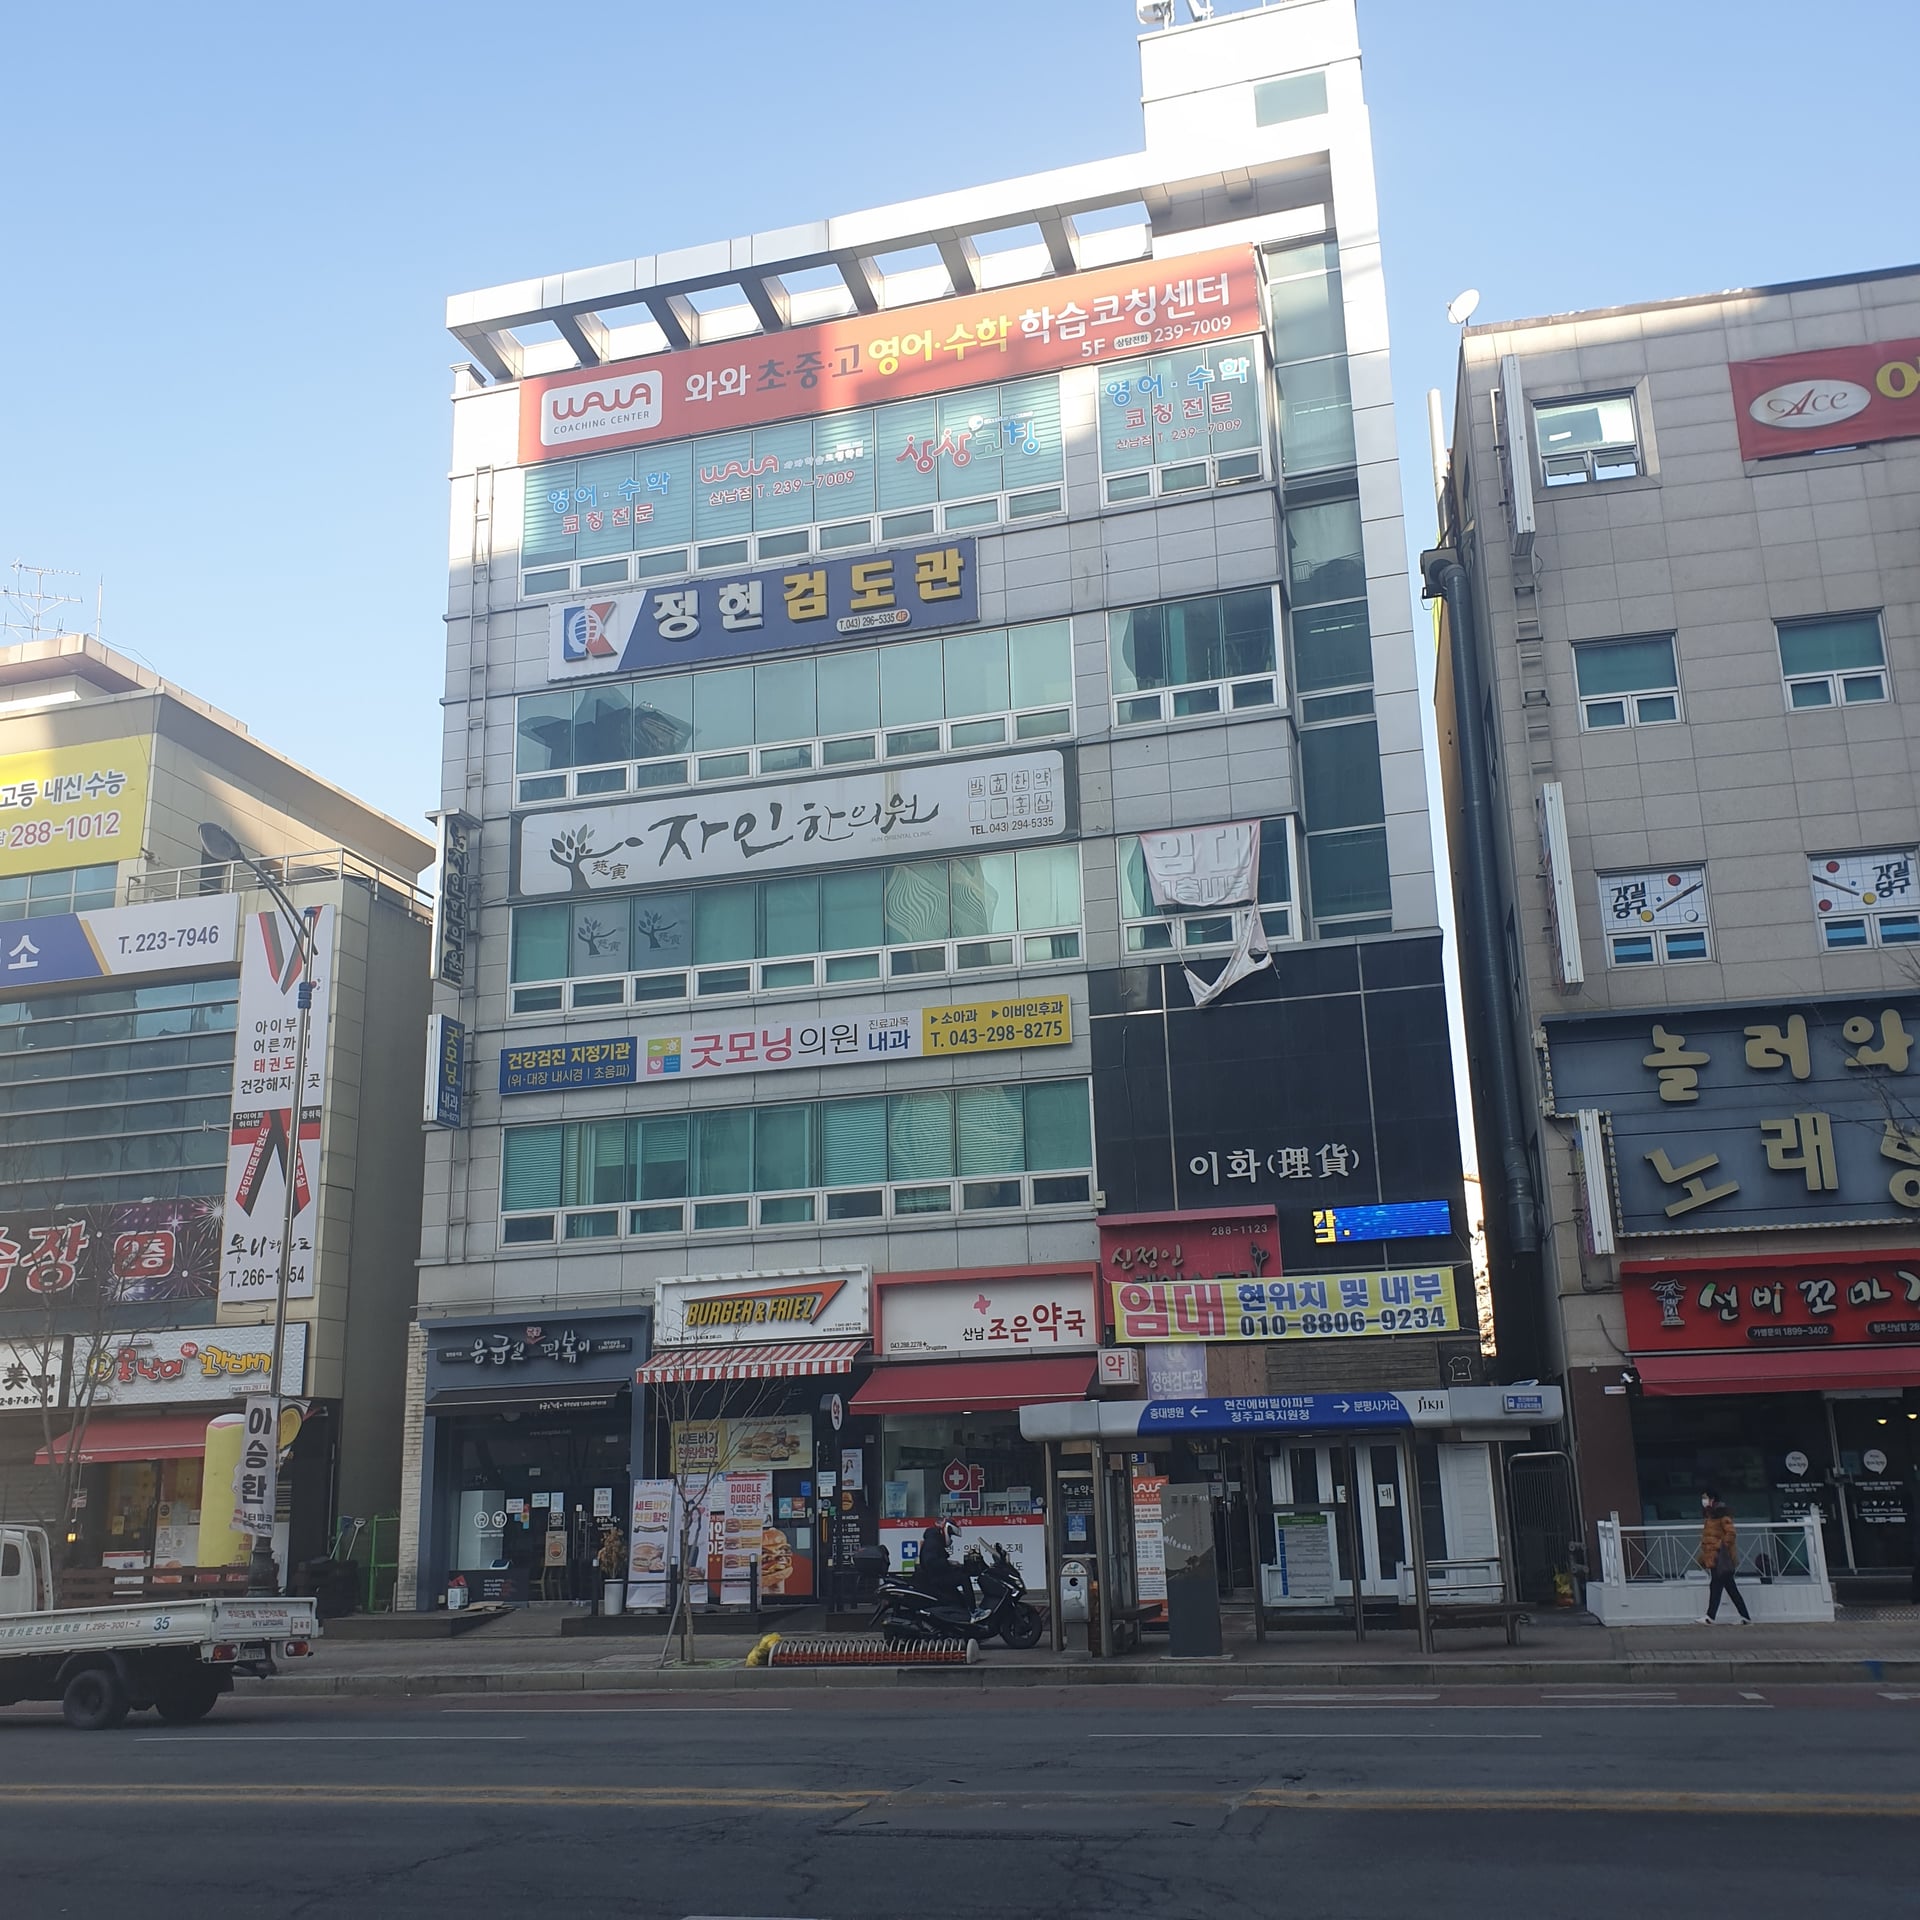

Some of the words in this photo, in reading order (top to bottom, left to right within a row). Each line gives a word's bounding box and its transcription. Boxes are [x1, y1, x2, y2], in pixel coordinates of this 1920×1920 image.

[684, 365, 751, 402] 와와
[1018, 274, 1230, 345] 학습코칭센터
[1115, 332, 1150, 348] 상담전화
[1154, 316, 1232, 343] 239-7009
[1081, 339, 1106, 357] 5F
[1767, 388, 1848, 420] Ace
[553, 417, 607, 435] COACHING
[610, 411, 650, 428] CENTER
[895, 419, 1041, 473] 상상코칭
[1116, 435, 1153, 450] 산남점
[709, 488, 753, 507] 산남점
[10, 812, 120, 847] 288-1012
[649, 793, 939, 864] 자인한의원
[1012, 816, 1054, 831] 294-5335
[868, 1016, 910, 1031] 진료과목
[941, 1009, 978, 1024] 소아과
[1002, 1001, 1064, 1019] 이비인후과
[868, 1029, 911, 1052] 내과
[507, 1050, 567, 1071] 건강검진
[571, 1042, 631, 1064] 지정기관
[307, 1073, 320, 1088] 곳
[551, 1068, 583, 1084] 내시경
[1211, 1223, 1268, 1236] 288-1123
[686, 1299, 752, 1327] BURGER
[754, 1302, 766, 1323] &
[767, 1294, 818, 1321] FRIEZ
[1119, 1284, 1227, 1339] 임대
[1236, 1281, 1327, 1312] 현위치
[1338, 1279, 1368, 1308] 및
[1381, 1273, 1443, 1305] 내부
[962, 1327, 984, 1341] 산남
[987, 1302, 1086, 1343] 조은약국
[1240, 1306, 1446, 1337] 010-8806-9234
[1782, 1325, 1829, 1336] 1899-3402
[470, 1335, 525, 1365] 응급실
[118, 1347, 183, 1381] 못난이
[1105, 1354, 1125, 1378] 약
[1353, 1399, 1400, 1412] 분평사거리
[242, 1407, 277, 1505] 이승환
[730, 1495, 762, 1504] BURGER
[731, 1483, 761, 1493] DOUBLE
[153, 1616, 171, 1631] 35
